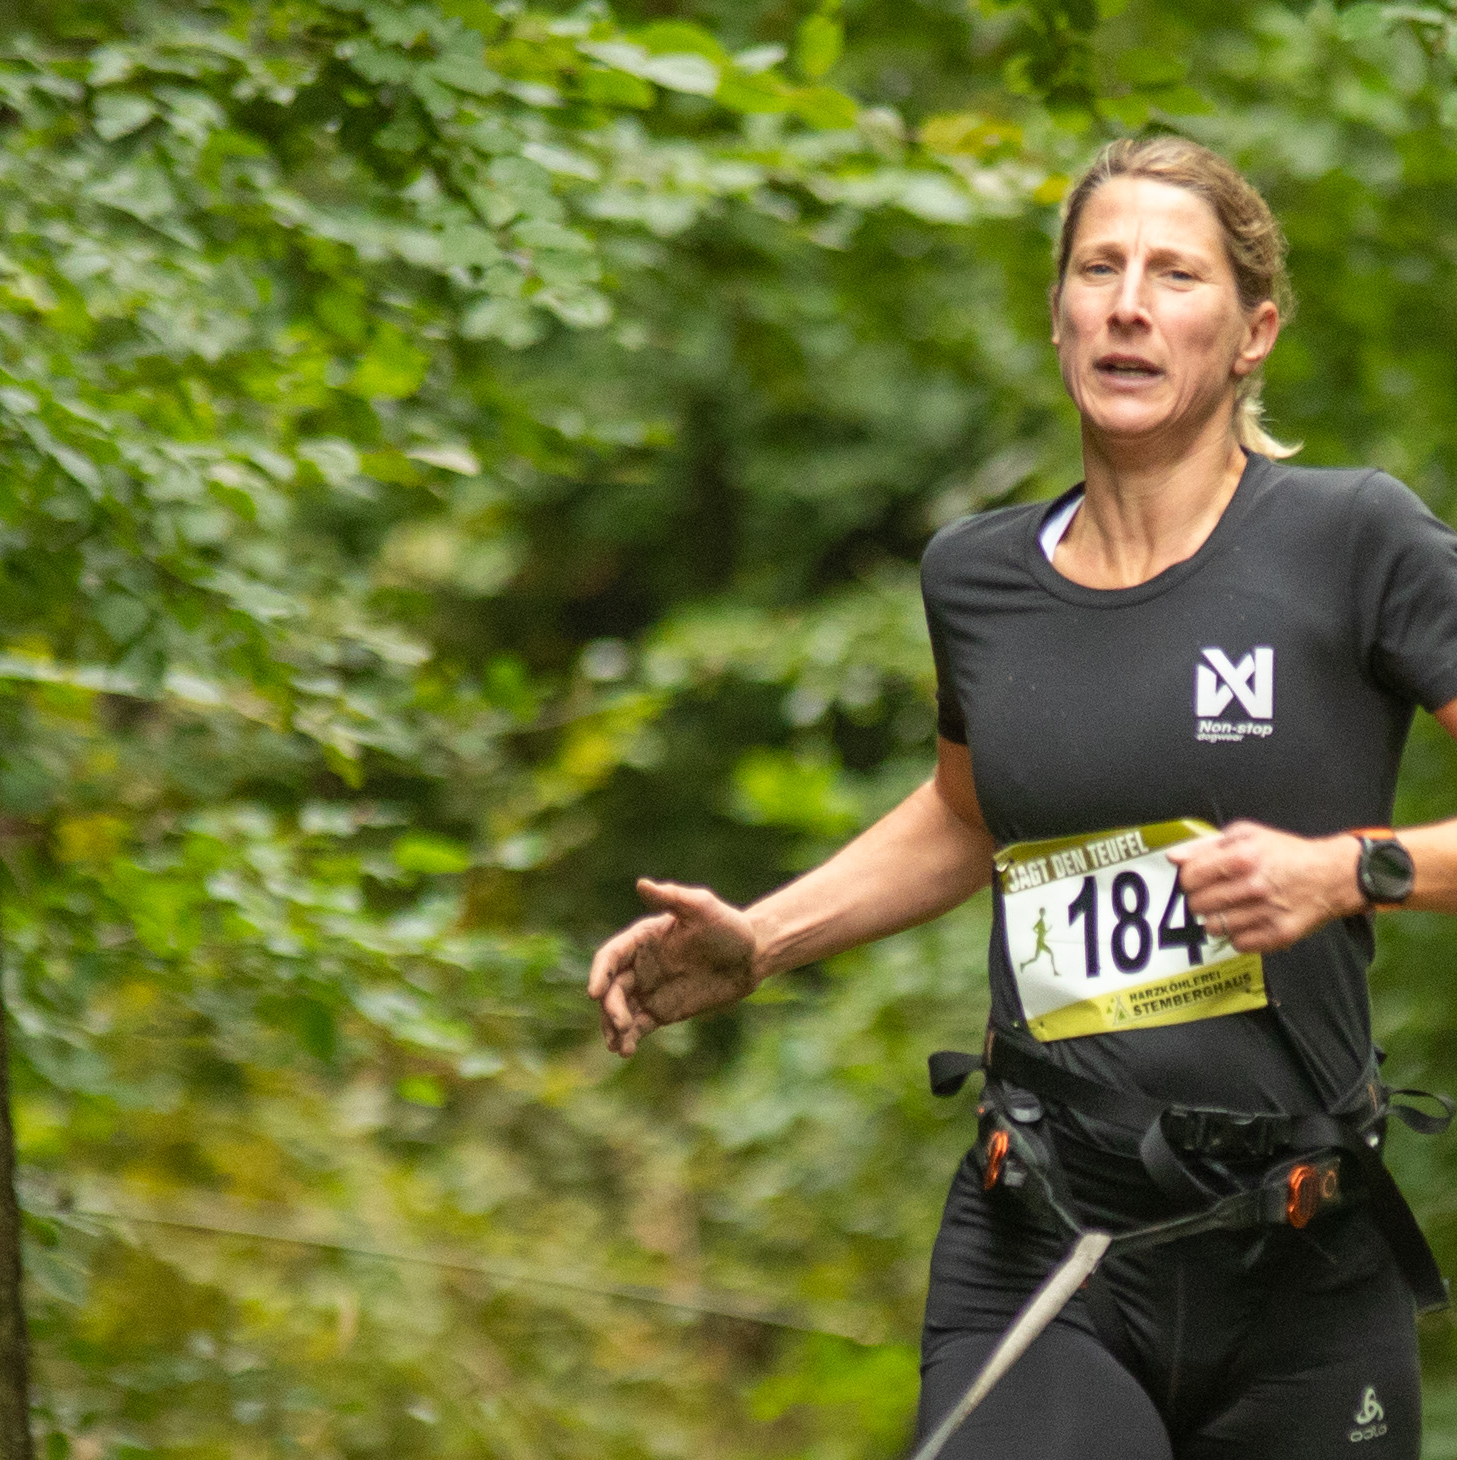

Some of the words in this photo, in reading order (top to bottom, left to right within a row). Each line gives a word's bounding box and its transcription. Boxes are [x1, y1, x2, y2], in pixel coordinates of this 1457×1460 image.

[1198, 720, 1274, 738] Non-stop
[1009, 859, 1050, 892] JAGT
[1050, 849, 1088, 879] DEN
[1086, 831, 1149, 867] TEUFEL
[1068, 870, 1207, 979] 184
[1133, 972, 1252, 1016] STEMBERGHAUS
